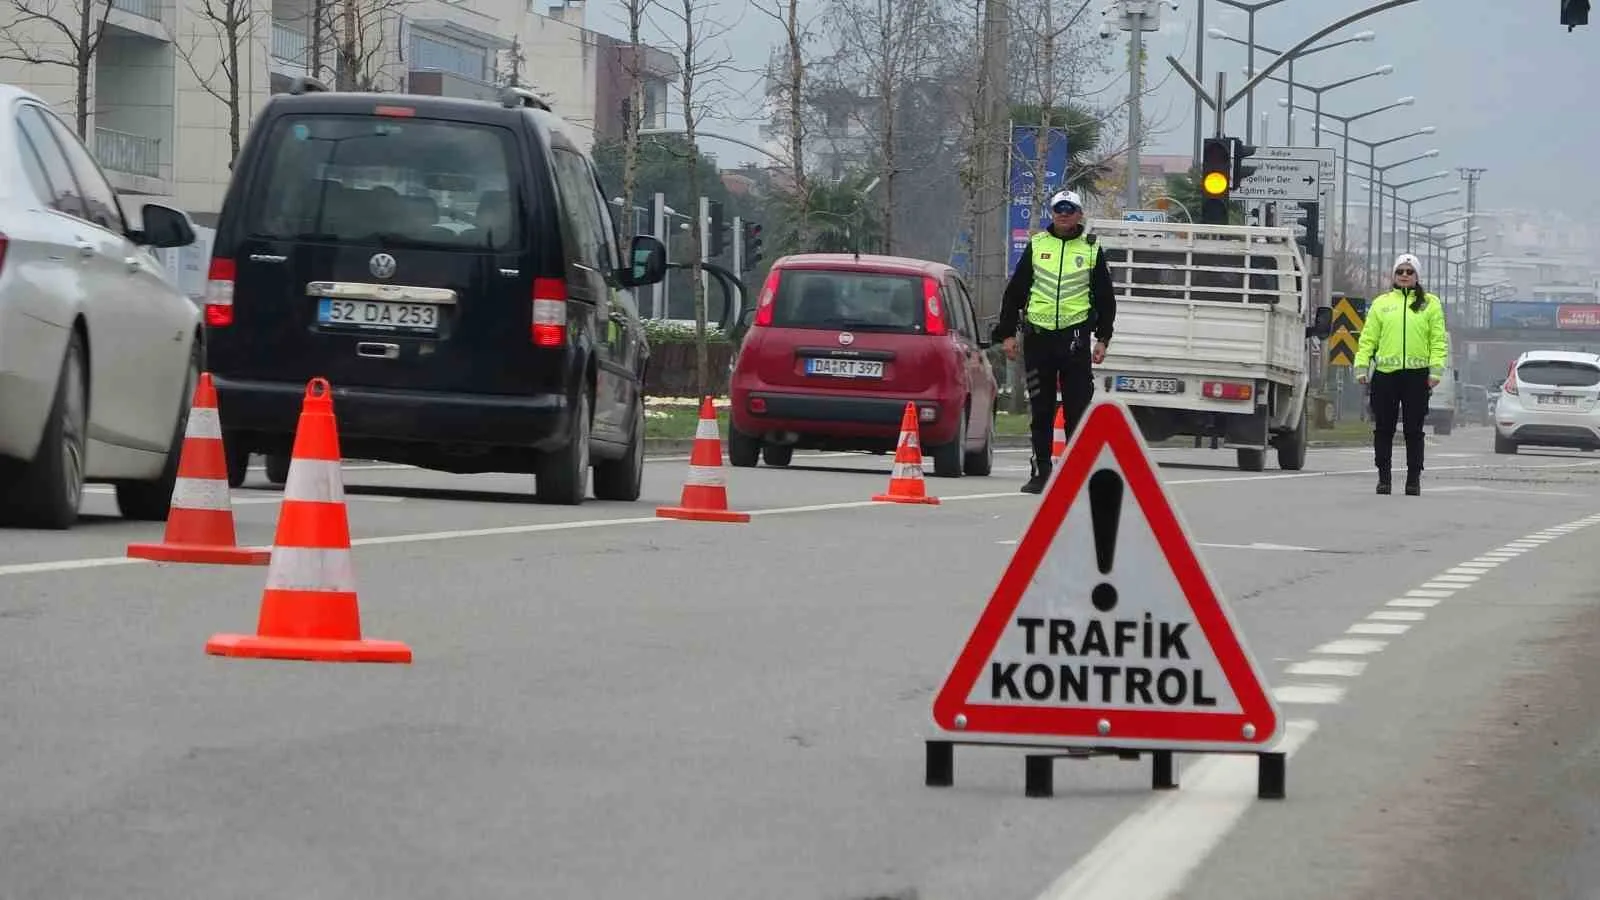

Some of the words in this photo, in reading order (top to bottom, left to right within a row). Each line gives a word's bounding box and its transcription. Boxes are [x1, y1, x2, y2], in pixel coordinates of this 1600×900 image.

[331, 301, 356, 321] 52
[363, 303, 393, 323] DA
[397, 306, 436, 326] 253
[815, 359, 832, 372] DA
[838, 361, 857, 375] RT
[859, 362, 881, 375] 397
[1016, 611, 1192, 660] TRAFİK
[991, 661, 1217, 707] KONTROL
